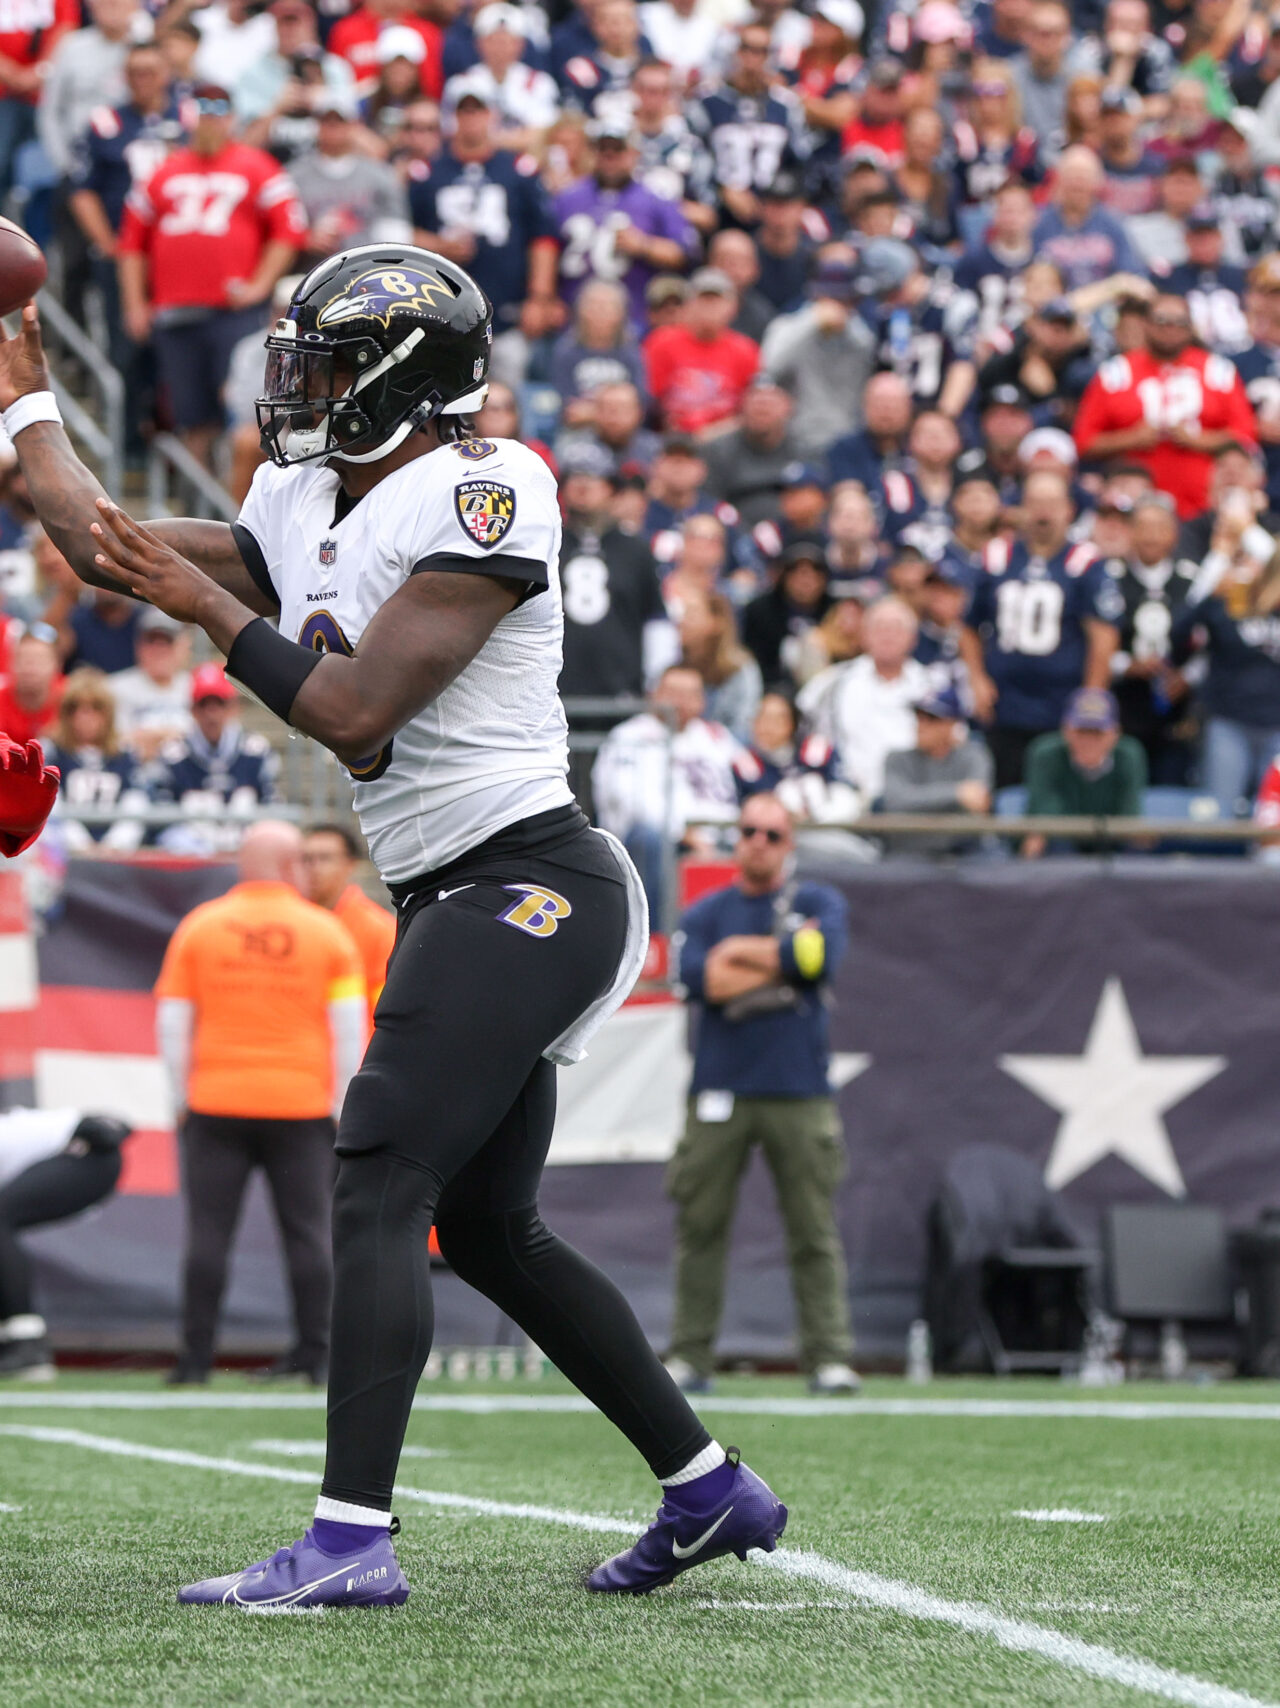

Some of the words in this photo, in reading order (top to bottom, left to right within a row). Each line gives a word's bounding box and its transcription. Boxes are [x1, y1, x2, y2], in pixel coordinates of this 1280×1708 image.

[160, 171, 250, 237] 37
[458, 482, 512, 497] RAVENS
[460, 493, 488, 512] B
[321, 550, 335, 561] NFL
[306, 590, 339, 602] RAVENS
[564, 555, 611, 626] 8
[996, 579, 1064, 656] 10
[495, 883, 572, 939] B
[347, 1566, 388, 1593] VAPOR
